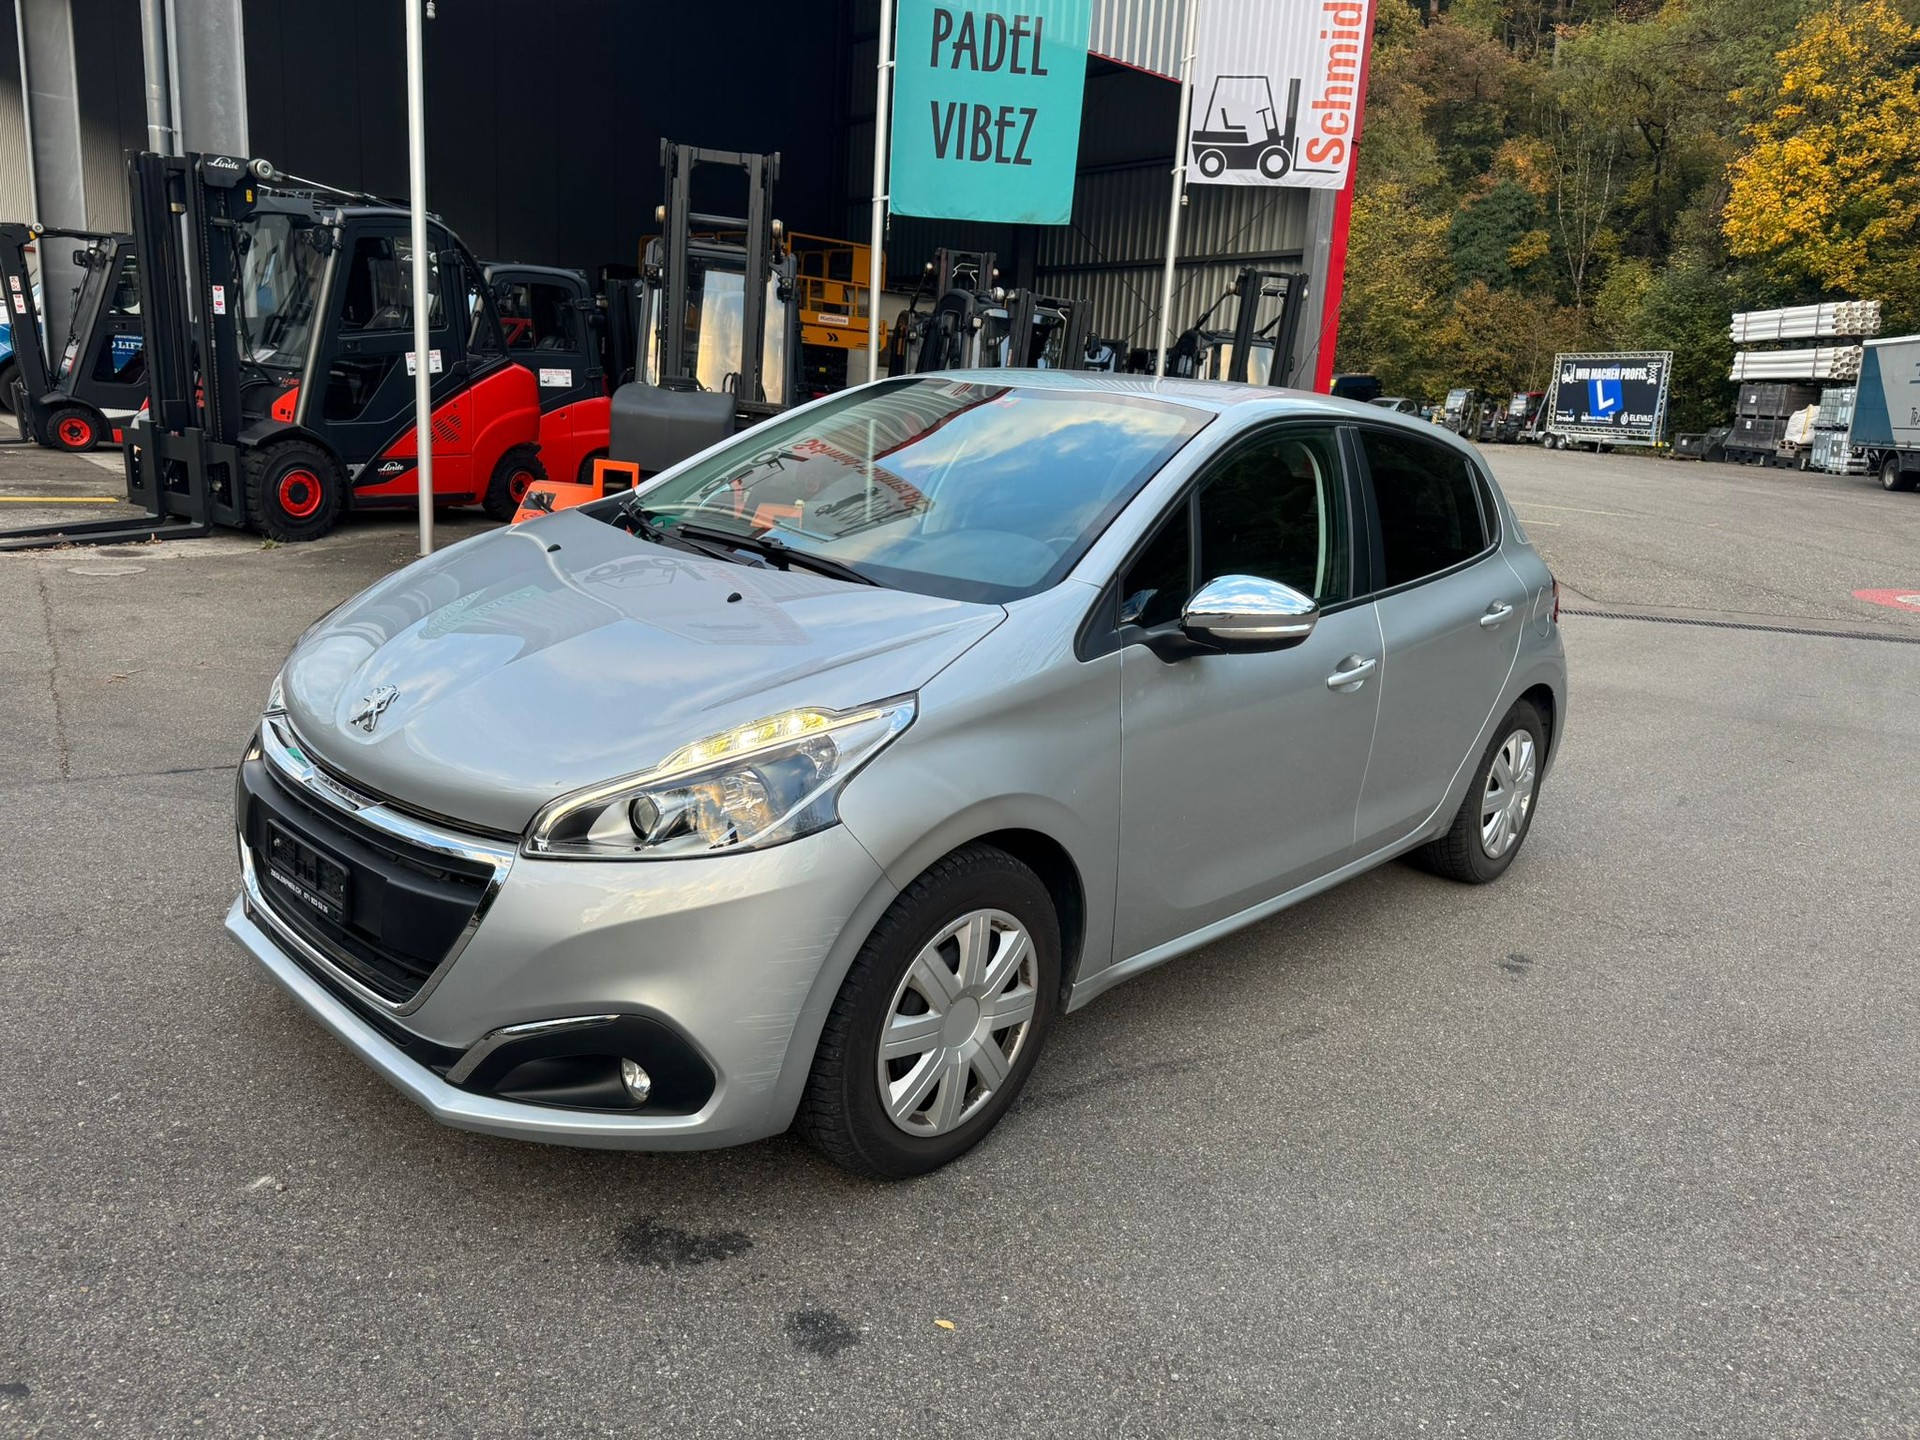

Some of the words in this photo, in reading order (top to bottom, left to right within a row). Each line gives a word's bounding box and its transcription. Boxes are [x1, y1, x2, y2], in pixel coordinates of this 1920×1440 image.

[929, 7, 1048, 77] PADEL
[1306, 1, 1363, 165] Schmid
[930, 100, 1038, 166] VIBEZ
[207, 156, 239, 170] Linde
[1575, 368, 1590, 380] WIR
[1590, 368, 1620, 381] MACHEN
[1620, 368, 1648, 380] PROFIS.
[1596, 379, 1615, 410] L
[1629, 414, 1653, 422] ELEVAG
[377, 461, 404, 471] Linde
